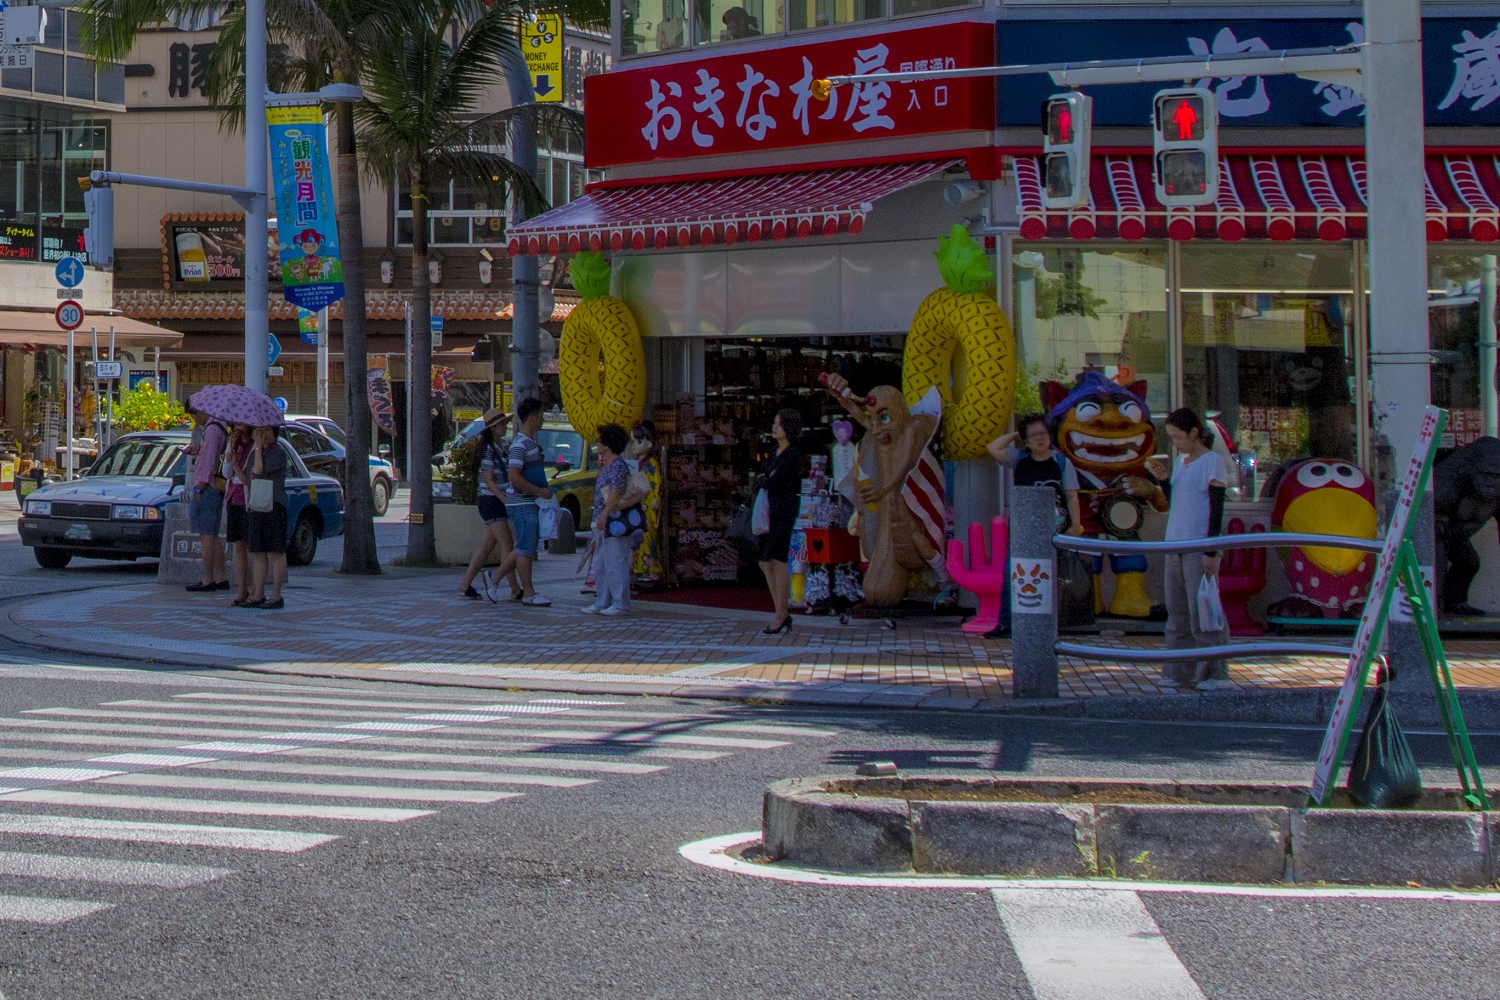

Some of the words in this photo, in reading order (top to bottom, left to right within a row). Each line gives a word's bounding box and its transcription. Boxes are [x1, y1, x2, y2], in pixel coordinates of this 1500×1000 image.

[525, 52, 547, 61] MONEY
[898, 57, 957, 84] 国際通り
[640, 42, 896, 151] おきなわ屋
[906, 84, 949, 112] 入口
[6, 227, 34, 237] ディナータイム
[208, 255, 234, 264] 生ビール
[209, 264, 241, 277] 500円
[62, 309, 78, 322] 30
[1240, 410, 1278, 430] 免税店
